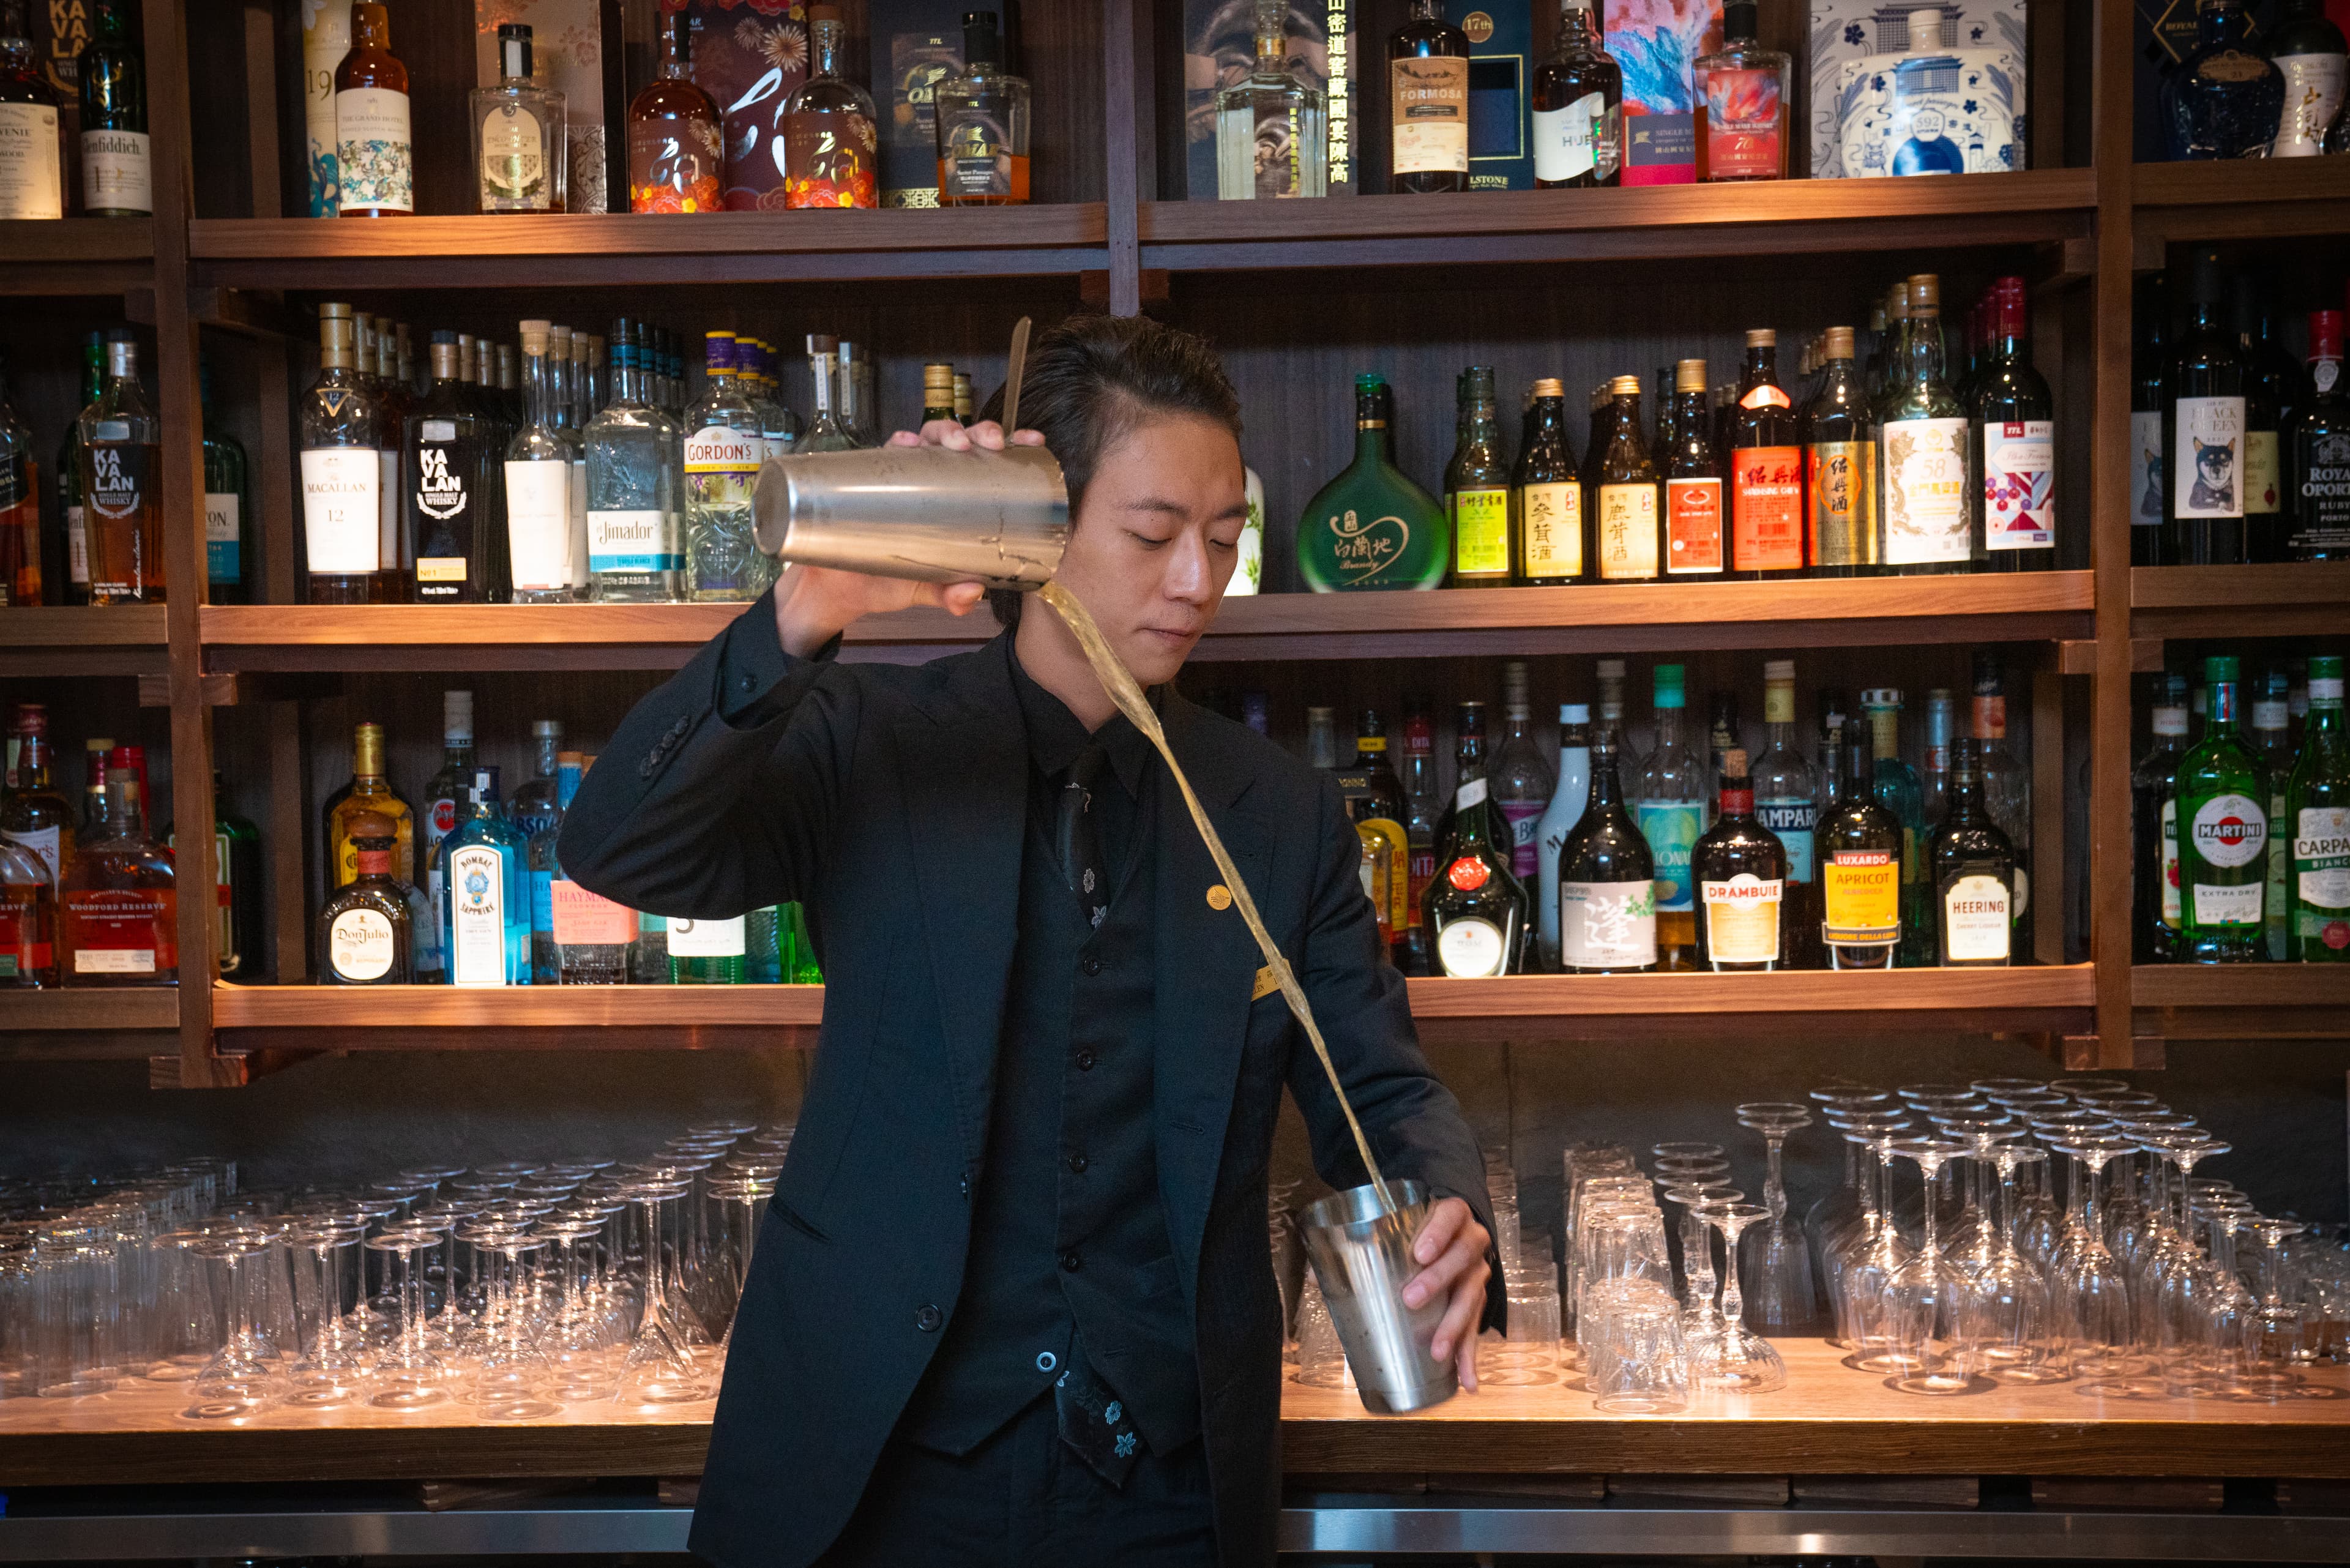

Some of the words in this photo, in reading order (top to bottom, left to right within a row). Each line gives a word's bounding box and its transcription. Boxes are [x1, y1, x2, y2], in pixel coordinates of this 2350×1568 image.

[1467, 18, 1491, 31] 17th
[1400, 88, 1462, 100] FORMOSA
[420, 449, 449, 465] KA
[688, 442, 752, 461] GORDON'S
[421, 464, 449, 478] VA
[1920, 458, 1946, 479] 58
[96, 476, 134, 491] LAN
[308, 483, 367, 493] MACALLAN
[421, 477, 461, 491] LAN
[2319, 501, 2350, 510] RUBY
[327, 509, 345, 522] 12
[2321, 513, 2349, 522] PORTO
[599, 521, 652, 545] Jimador
[2199, 824, 2261, 837] MARTINI
[1837, 854, 1889, 865] LUXARDO
[1836, 873, 1889, 885] APRICOT
[1709, 886, 1778, 898] DRAMBUIE
[69, 903, 119, 911] WOODFORD
[121, 902, 166, 911] RESERVE
[1953, 900, 2004, 914] HEERING
[336, 928, 363, 941] Don
